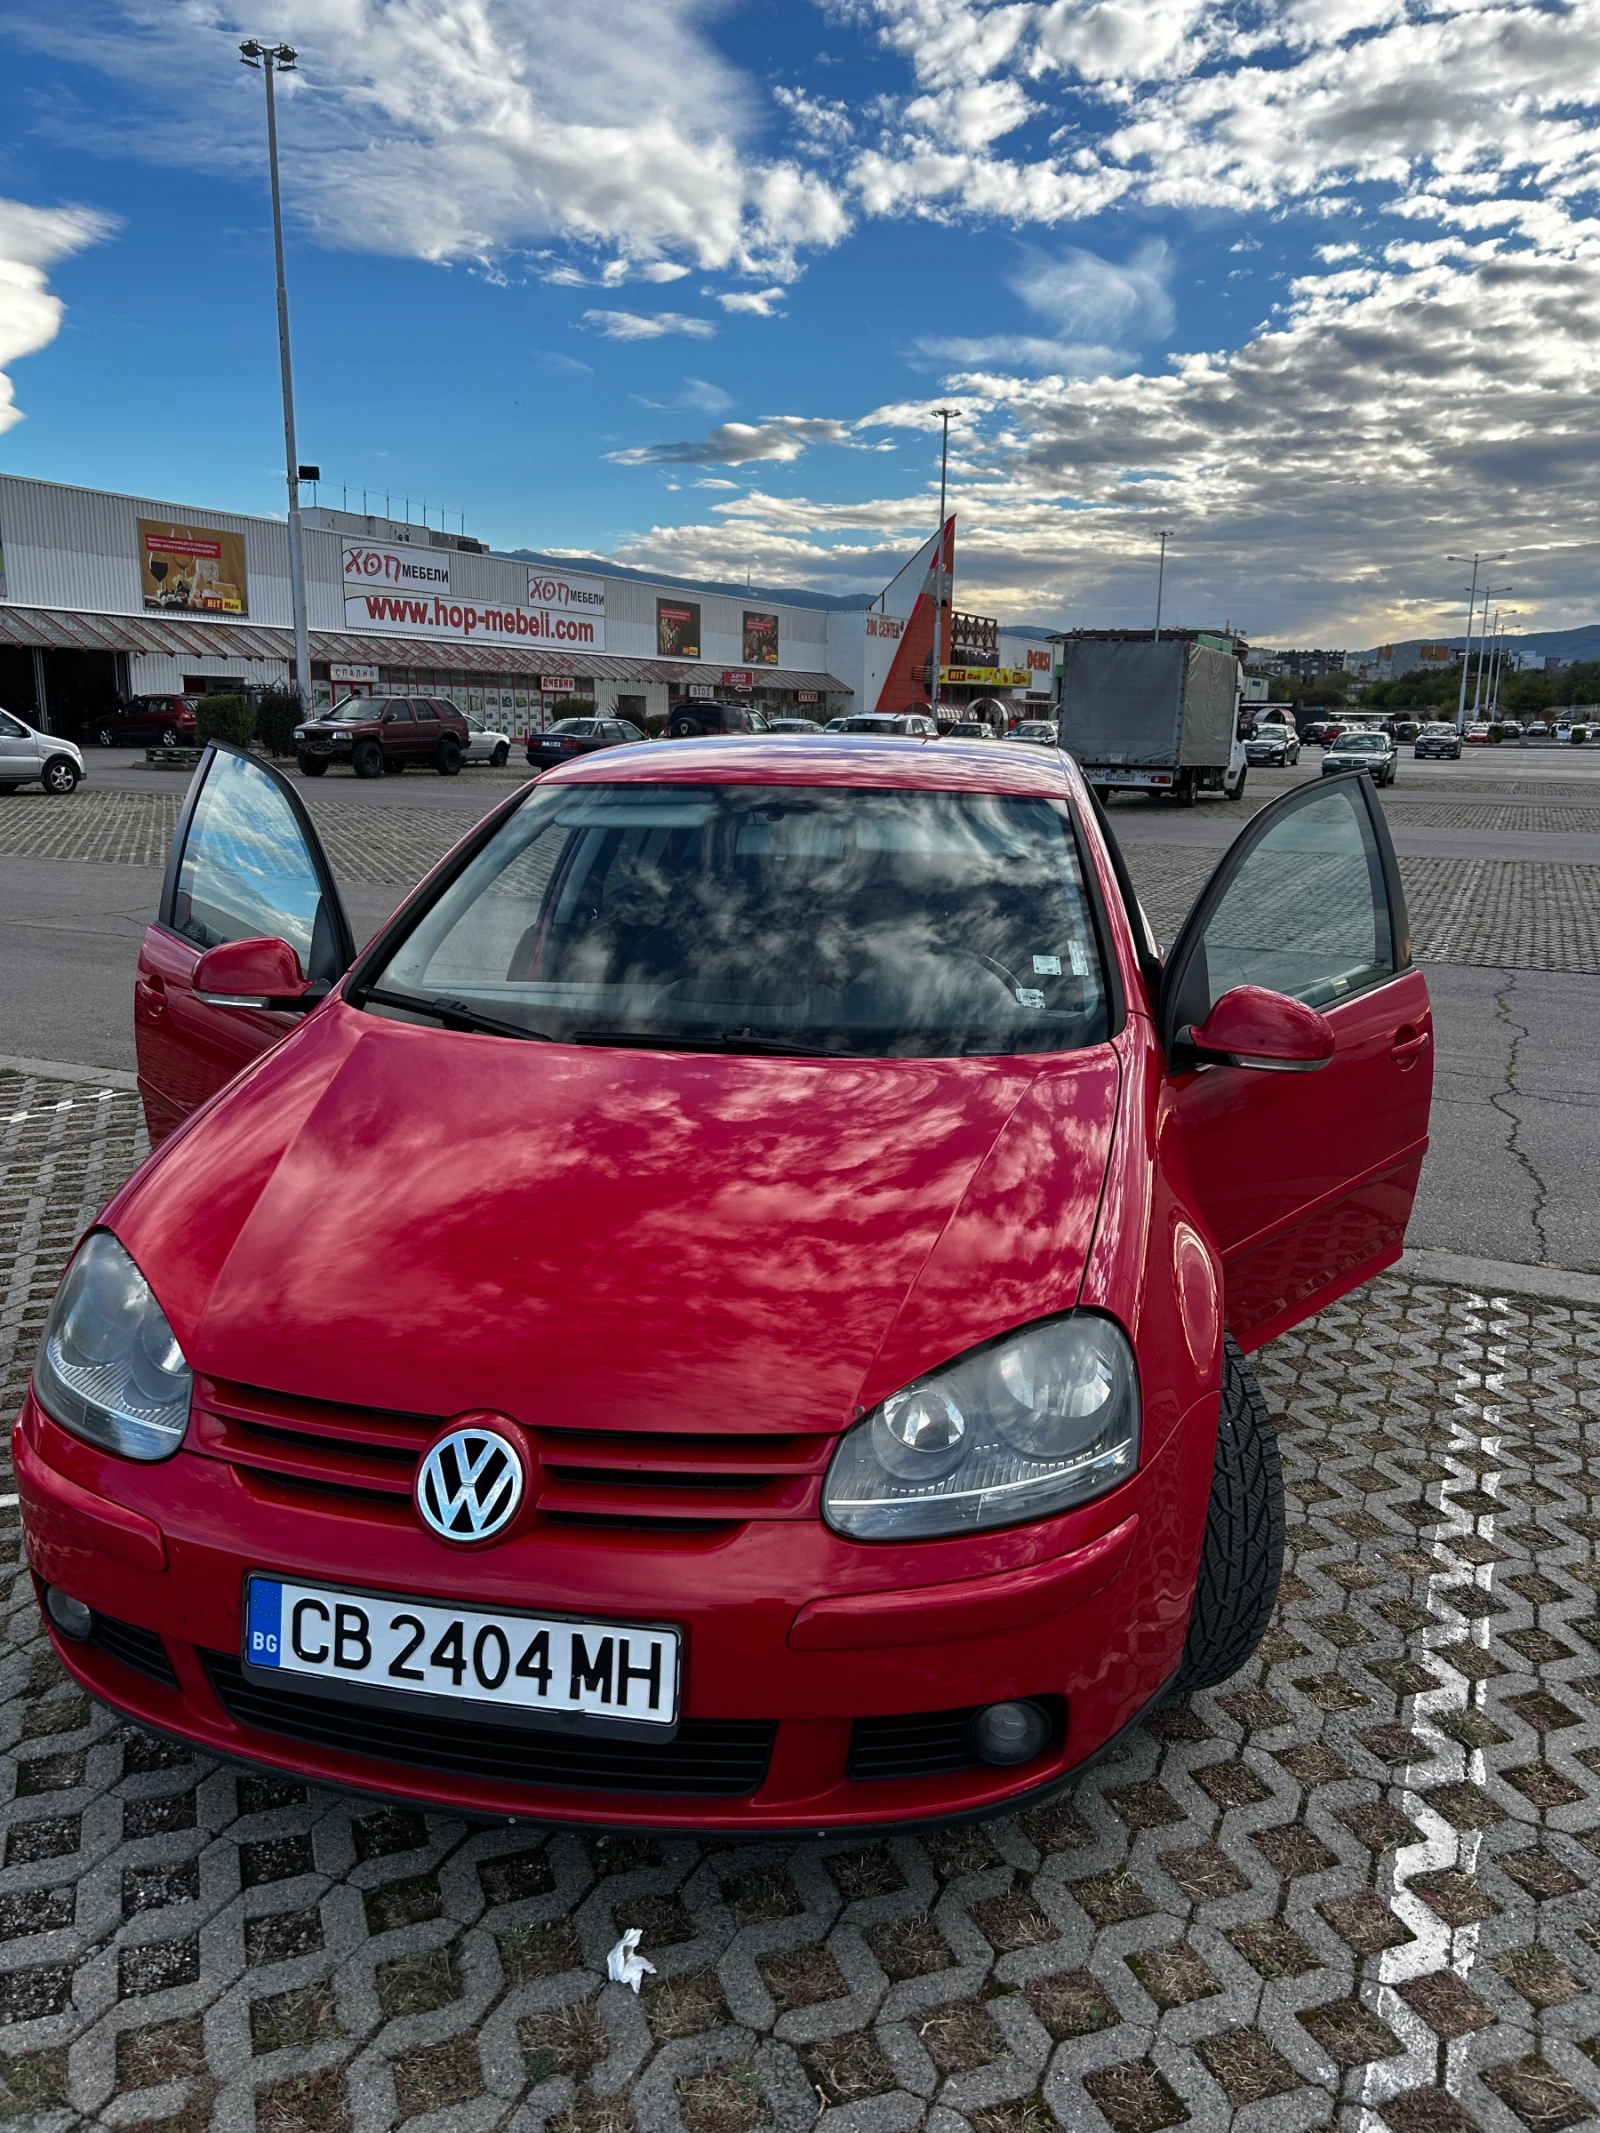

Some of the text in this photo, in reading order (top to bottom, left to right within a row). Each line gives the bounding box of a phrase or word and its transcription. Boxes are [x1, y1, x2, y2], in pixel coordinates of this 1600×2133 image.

[344, 548, 449, 583] ХОП МЕБЕЛИ
[207, 599, 221, 608] HIT
[529, 578, 605, 607] ХОП МЕБЕЛИ
[365, 596, 594, 643] www.hop-mebeli.com
[866, 618, 900, 639] ZOO CENTER
[335, 668, 375, 678] СПАЛНИ
[543, 677, 574, 689] ДНЕВНИ
[950, 671, 964, 680] HIT
[252, 1630, 278, 1654] BG
[388, 1614, 553, 1697] 2404
